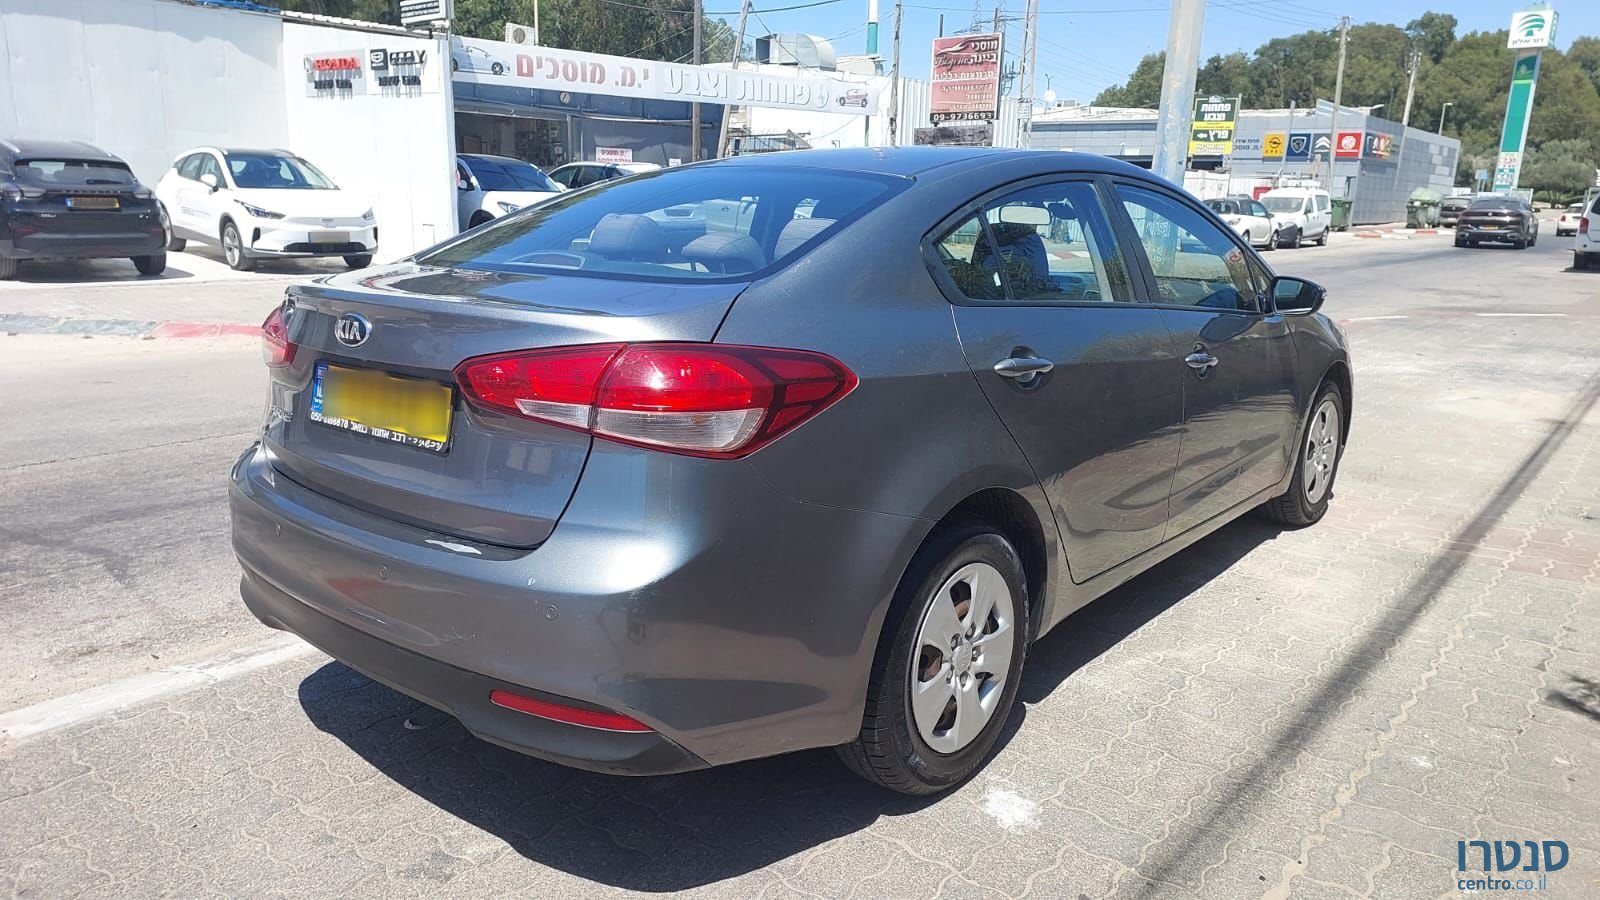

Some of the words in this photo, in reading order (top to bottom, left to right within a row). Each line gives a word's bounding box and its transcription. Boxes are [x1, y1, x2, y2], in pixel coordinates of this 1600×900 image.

[516, 54, 606, 85] מוסכים
[664, 68, 728, 98] וצבע
[737, 78, 811, 106] פחחות
[933, 112, 992, 121] 09-9736693
[1200, 103, 1232, 112] פחחות
[1208, 130, 1229, 141] פרץ
[336, 319, 361, 341] KIA
